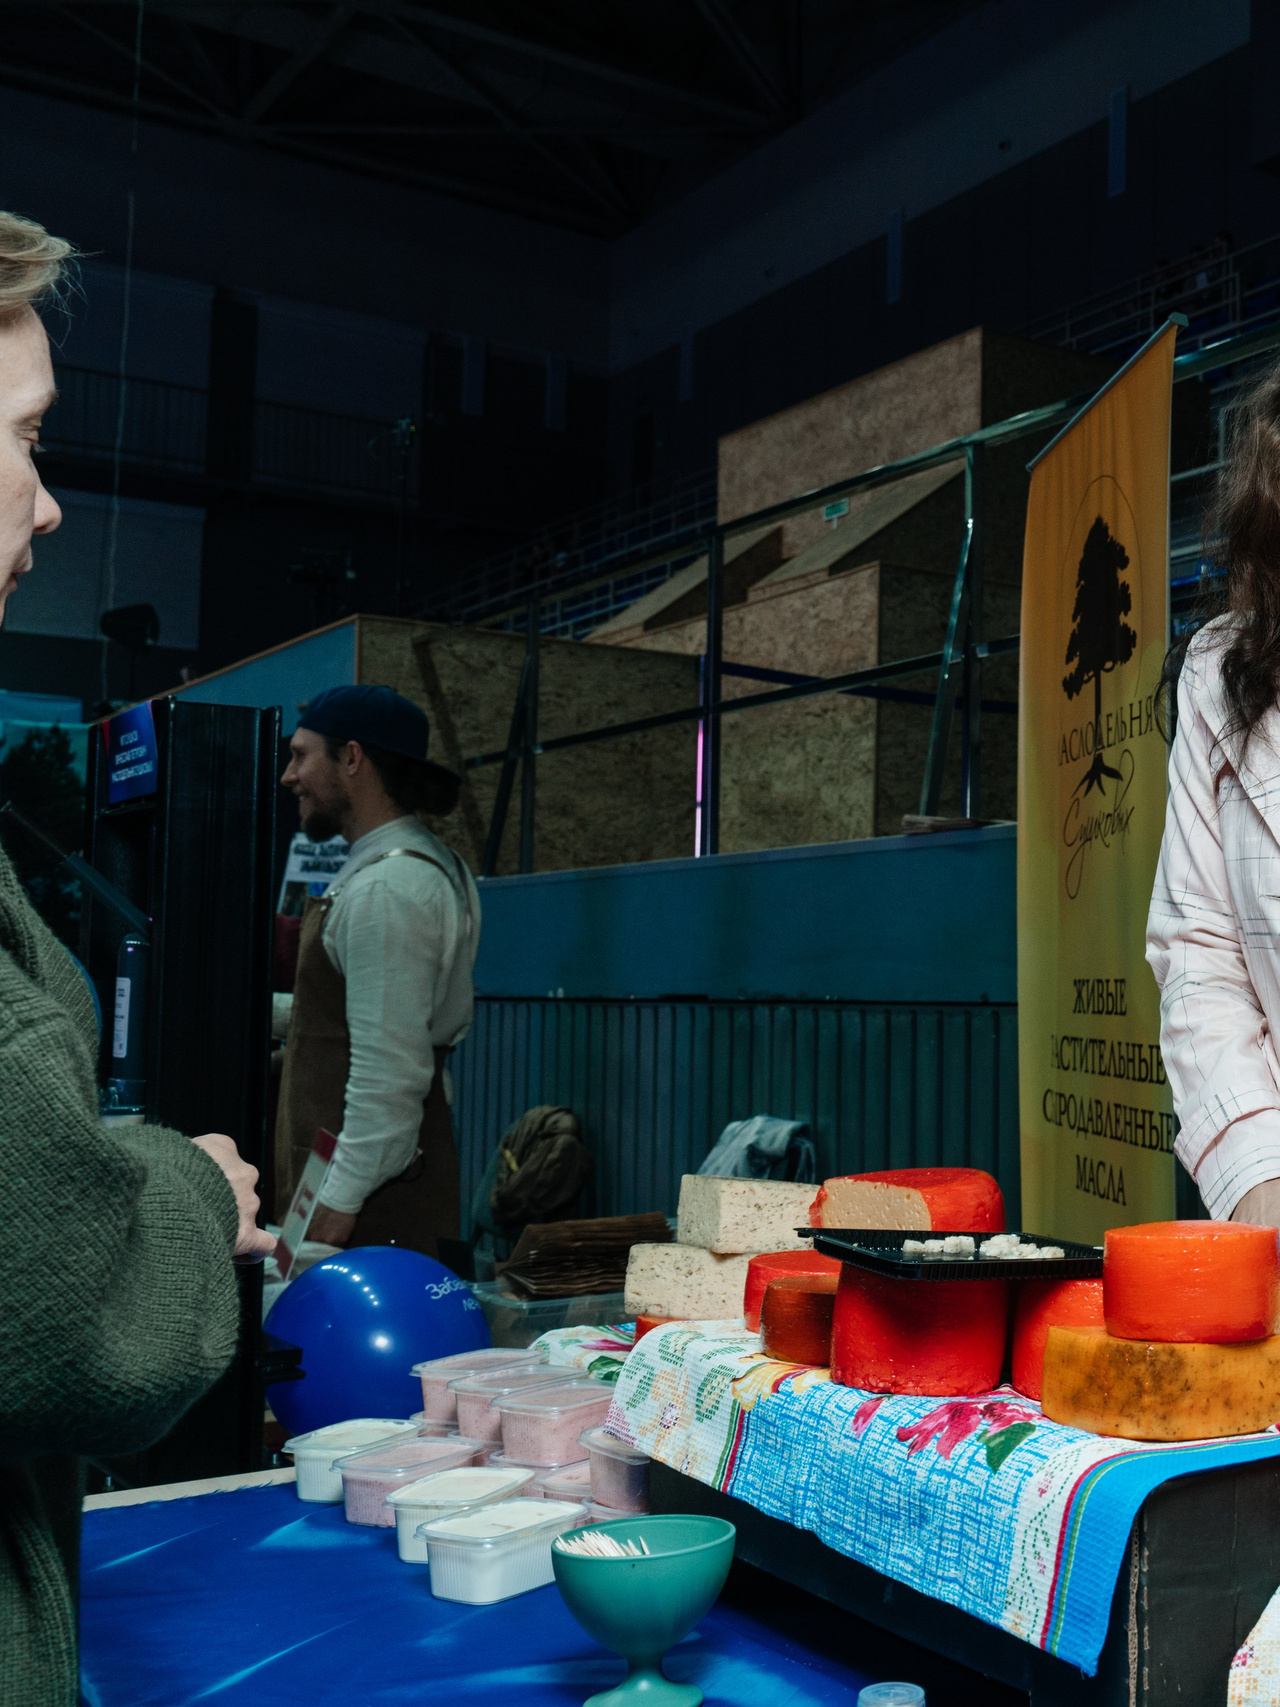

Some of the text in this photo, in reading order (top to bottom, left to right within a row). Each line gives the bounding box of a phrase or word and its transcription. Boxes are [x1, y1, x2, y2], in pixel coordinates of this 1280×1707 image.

[1057, 694, 1154, 767] АСЛОДЕЛЬНЯ
[1072, 978, 1128, 1017] ЖИВЫЕ
[1051, 1034, 1168, 1086] АСТИТЕЛЬНЫЕ
[1075, 1153, 1128, 1207] МАСЛА
